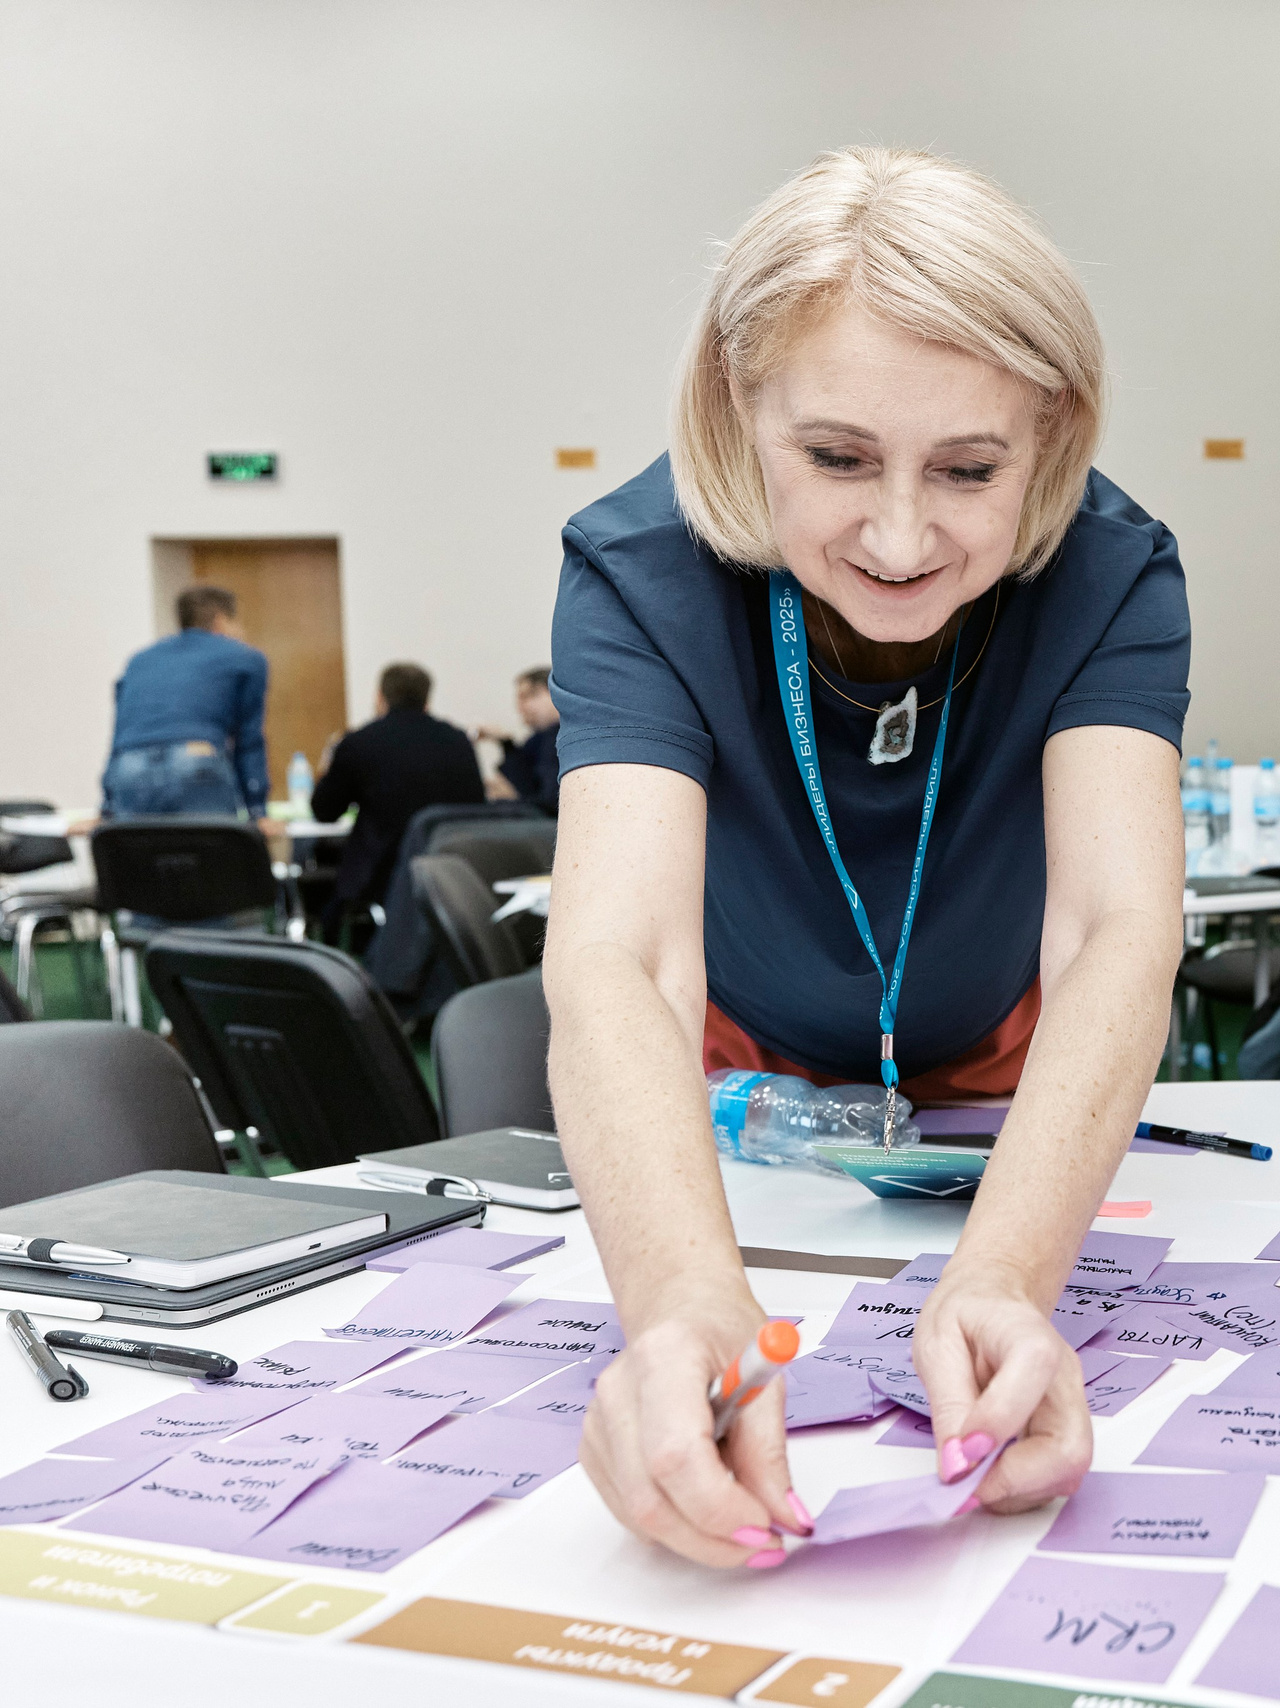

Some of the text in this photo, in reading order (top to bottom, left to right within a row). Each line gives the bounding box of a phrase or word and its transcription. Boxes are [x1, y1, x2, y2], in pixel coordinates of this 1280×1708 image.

[779, 586, 799, 643] 2025»
[787, 661, 814, 757] БИЗНЕСА
[797, 763, 838, 855] «ЛИДЕРЫ
[918, 757, 938, 851] «ЛИДЕРЫ
[899, 856, 922, 951] БИЗНЕСА
[1117, 1329, 1203, 1350] КАРТЫ
[295, 1600, 332, 1619] 1
[1042, 1608, 1177, 1655] CRM
[560, 1622, 678, 1656] услуги
[512, 1644, 693, 1686] Продукты
[812, 1671, 851, 1697] 2
